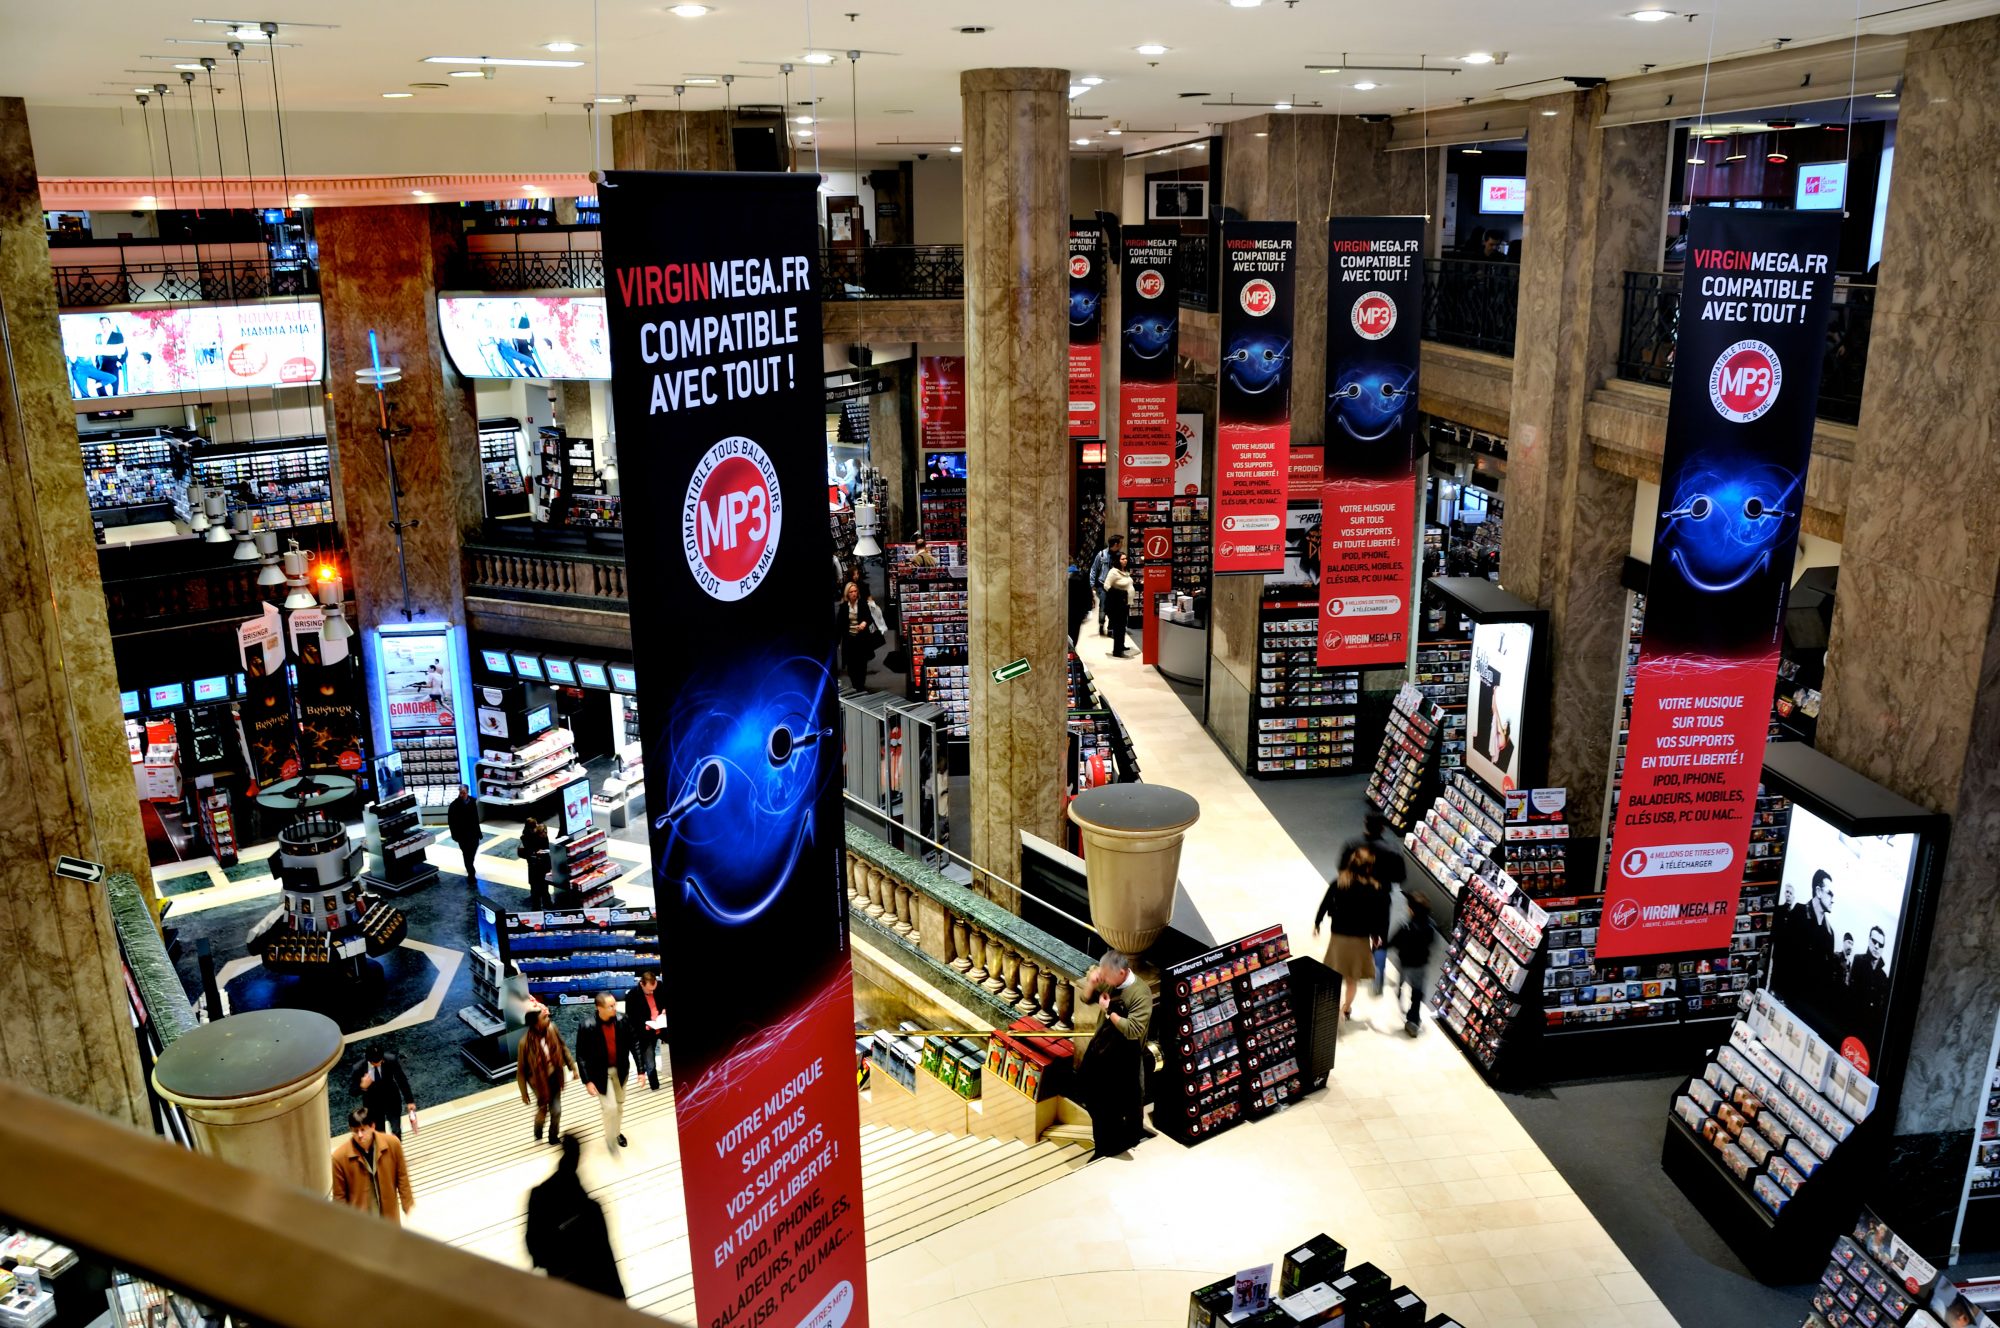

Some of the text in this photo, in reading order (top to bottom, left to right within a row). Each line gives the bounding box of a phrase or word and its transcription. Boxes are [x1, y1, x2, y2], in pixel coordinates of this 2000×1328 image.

[1227, 240, 1292, 249] VIRGINMEGA.FR
[1334, 240, 1418, 252] VIRGINMEGA.FR
[1232, 251, 1286, 261] COMPATIBLE
[1340, 255, 1411, 268] COMPATIBLE
[1694, 249, 1828, 274] VIRGINMEGA.FR
[1233, 262, 1284, 271] AVEC TOUT !
[617, 256, 810, 307] VIRGINMEGA.FR
[1342, 270, 1408, 282] AVEC TOUT !
[1141, 279, 1159, 290] MP3
[1701, 276, 1814, 300] COMPATIBLE
[1246, 291, 1270, 305] MP3
[1359, 307, 1389, 325] MP3
[1701, 301, 1806, 324] AVEC TOUT !
[241, 326, 286, 337] MAMMA
[640, 307, 798, 364] COMPATIBLE
[1711, 347, 1736, 395] COMPATIBLE
[1738, 342, 1756, 350] TOUS
[1758, 344, 1780, 386] BALADEURS
[650, 354, 795, 414] AVEC TOUT !
[1721, 367, 1771, 397] MP3
[1758, 400, 1770, 413] MAC
[1253, 469, 1276, 477] LIBERTÉ
[1364, 504, 1396, 512] MUSIQUE
[685, 440, 780, 595] 100% COMPATIBLE TOUS BALADEURS
[700, 485, 767, 557] MP3
[1350, 516, 1384, 524] SUR TOUS
[1341, 527, 1392, 536] VOS SUPPORTS
[1333, 538, 1396, 549] EN TOUTE LIBERTÉ
[1342, 552, 1360, 560] IPOD,
[740, 544, 774, 593] PC & MAC
[1327, 562, 1404, 572] BALADEURS, MOBILES,
[1372, 574, 1382, 582] OU
[243, 628, 268, 641] BRISINGR
[1344, 632, 1402, 644] VIRGINMEGA.FR
[390, 701, 437, 715] GOMORRA
[1658, 696, 1744, 710] VOTRE MUSIQUE
[1672, 715, 1724, 729] SUR TOUS
[1656, 734, 1735, 749] VOS SUPPORTS
[1641, 749, 1744, 769] EN TOUTE LIBERTÉ !
[1653, 771, 1726, 787] IPOD, IPHONE,
[1629, 789, 1745, 807] BALADEURS, MOBILES,
[1625, 808, 1742, 826] CLÉS USB, PC OU MAC...
[1655, 850, 1684, 859] MILLIONS
[1660, 860, 1712, 869] À TÉLÉCHARGER
[1613, 904, 1637, 924] Virgin
[1642, 900, 1728, 920] VIRGINMEGA.FR
[1173, 952, 1224, 975] Meilleures Ventes
[1244, 1018, 1252, 1026] 11
[1249, 1059, 1257, 1067] 13
[1252, 1081, 1260, 1089] 14
[715, 1057, 824, 1159] VOTRE MUSIQUE
[1254, 1100, 1262, 1108] 15
[1193, 1125, 1198, 1133] 8
[741, 1105, 806, 1174] SUR TOUS
[726, 1123, 824, 1220] VOS SUPPORTS
[714, 1140, 839, 1268] EN TOUTE LIBERTÉ !
[795, 1194, 851, 1256] MOBILES,
[736, 1188, 825, 1281] IPOD, IPHONE,
[781, 1228, 853, 1302] PC OU MAC...
[833, 1286, 847, 1307] MP3
